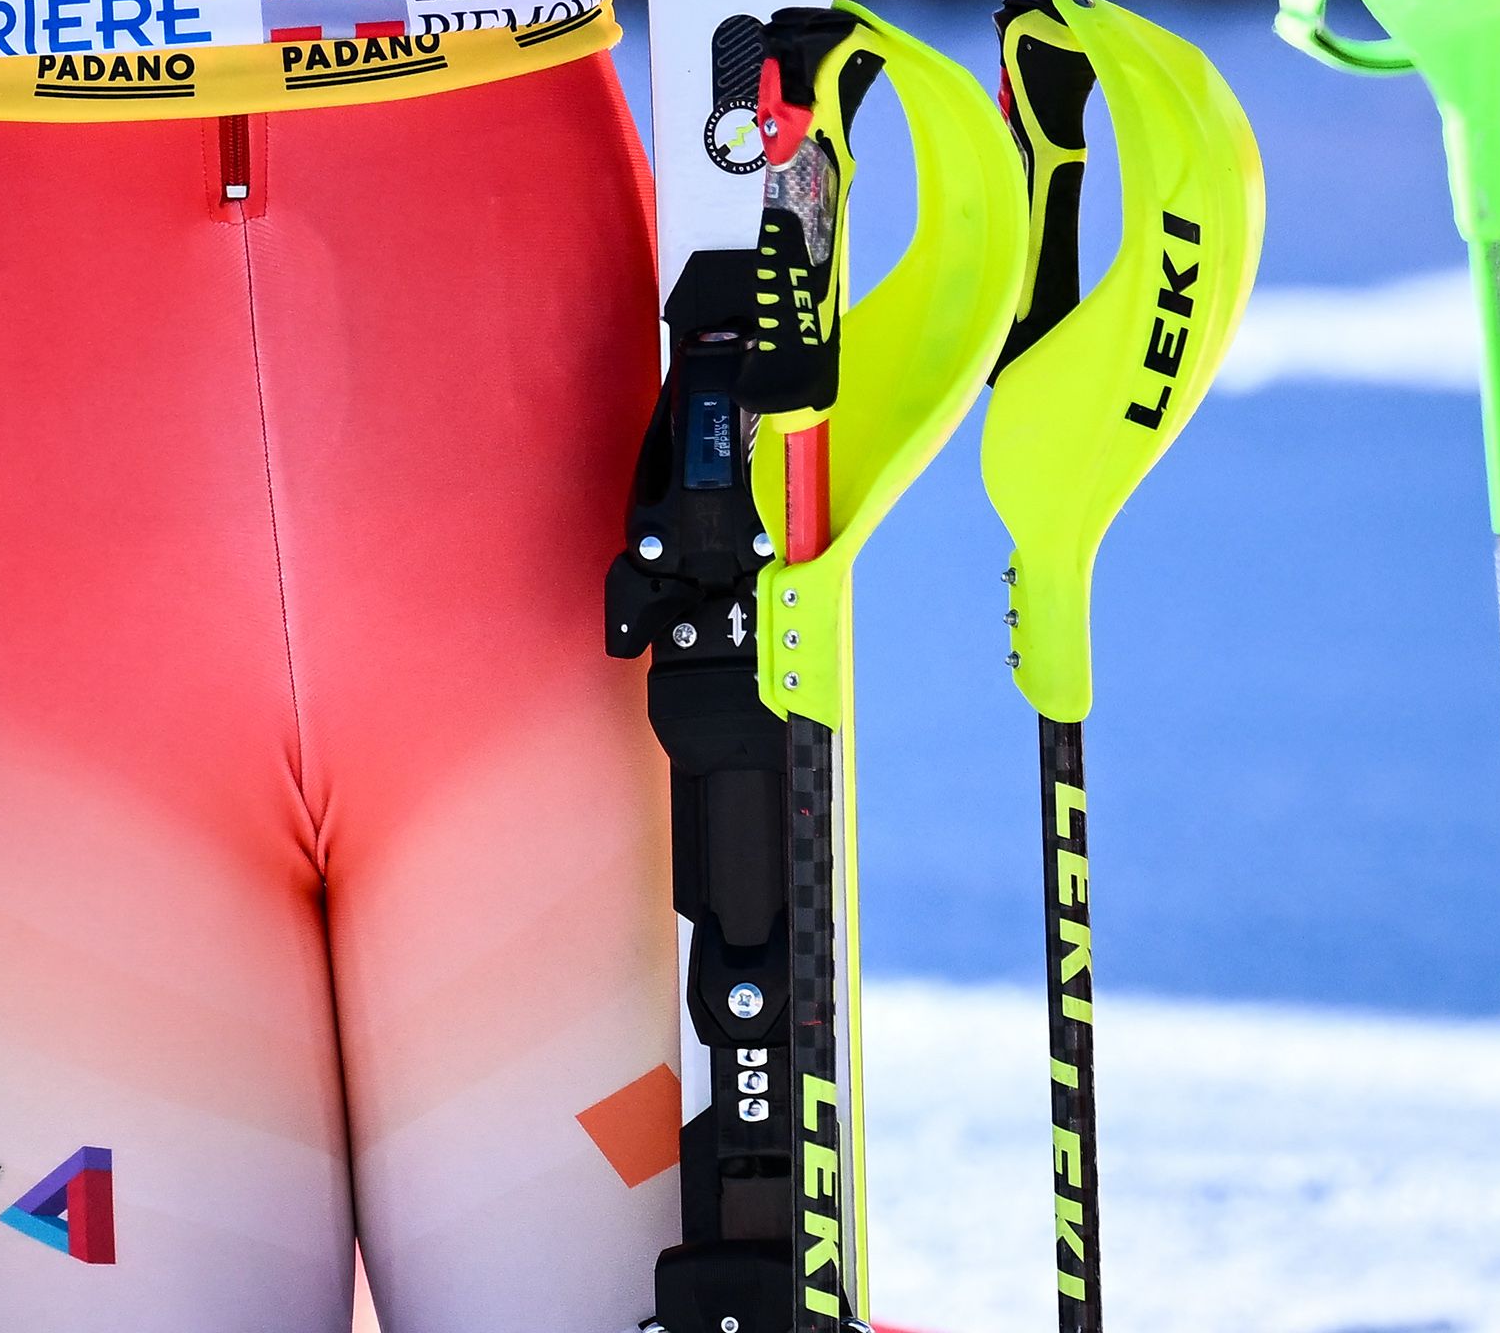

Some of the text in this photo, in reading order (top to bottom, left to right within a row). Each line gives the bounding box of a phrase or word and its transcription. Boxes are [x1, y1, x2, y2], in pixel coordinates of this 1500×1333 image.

[37, 53, 196, 83] PADANO
[729, 101, 758, 110] CIRCU
[789, 267, 819, 347] LEKI
[1124, 210, 1202, 431] LEKI
[1055, 781, 1095, 1027] LEKI
[803, 1072, 841, 1319] LEKI
